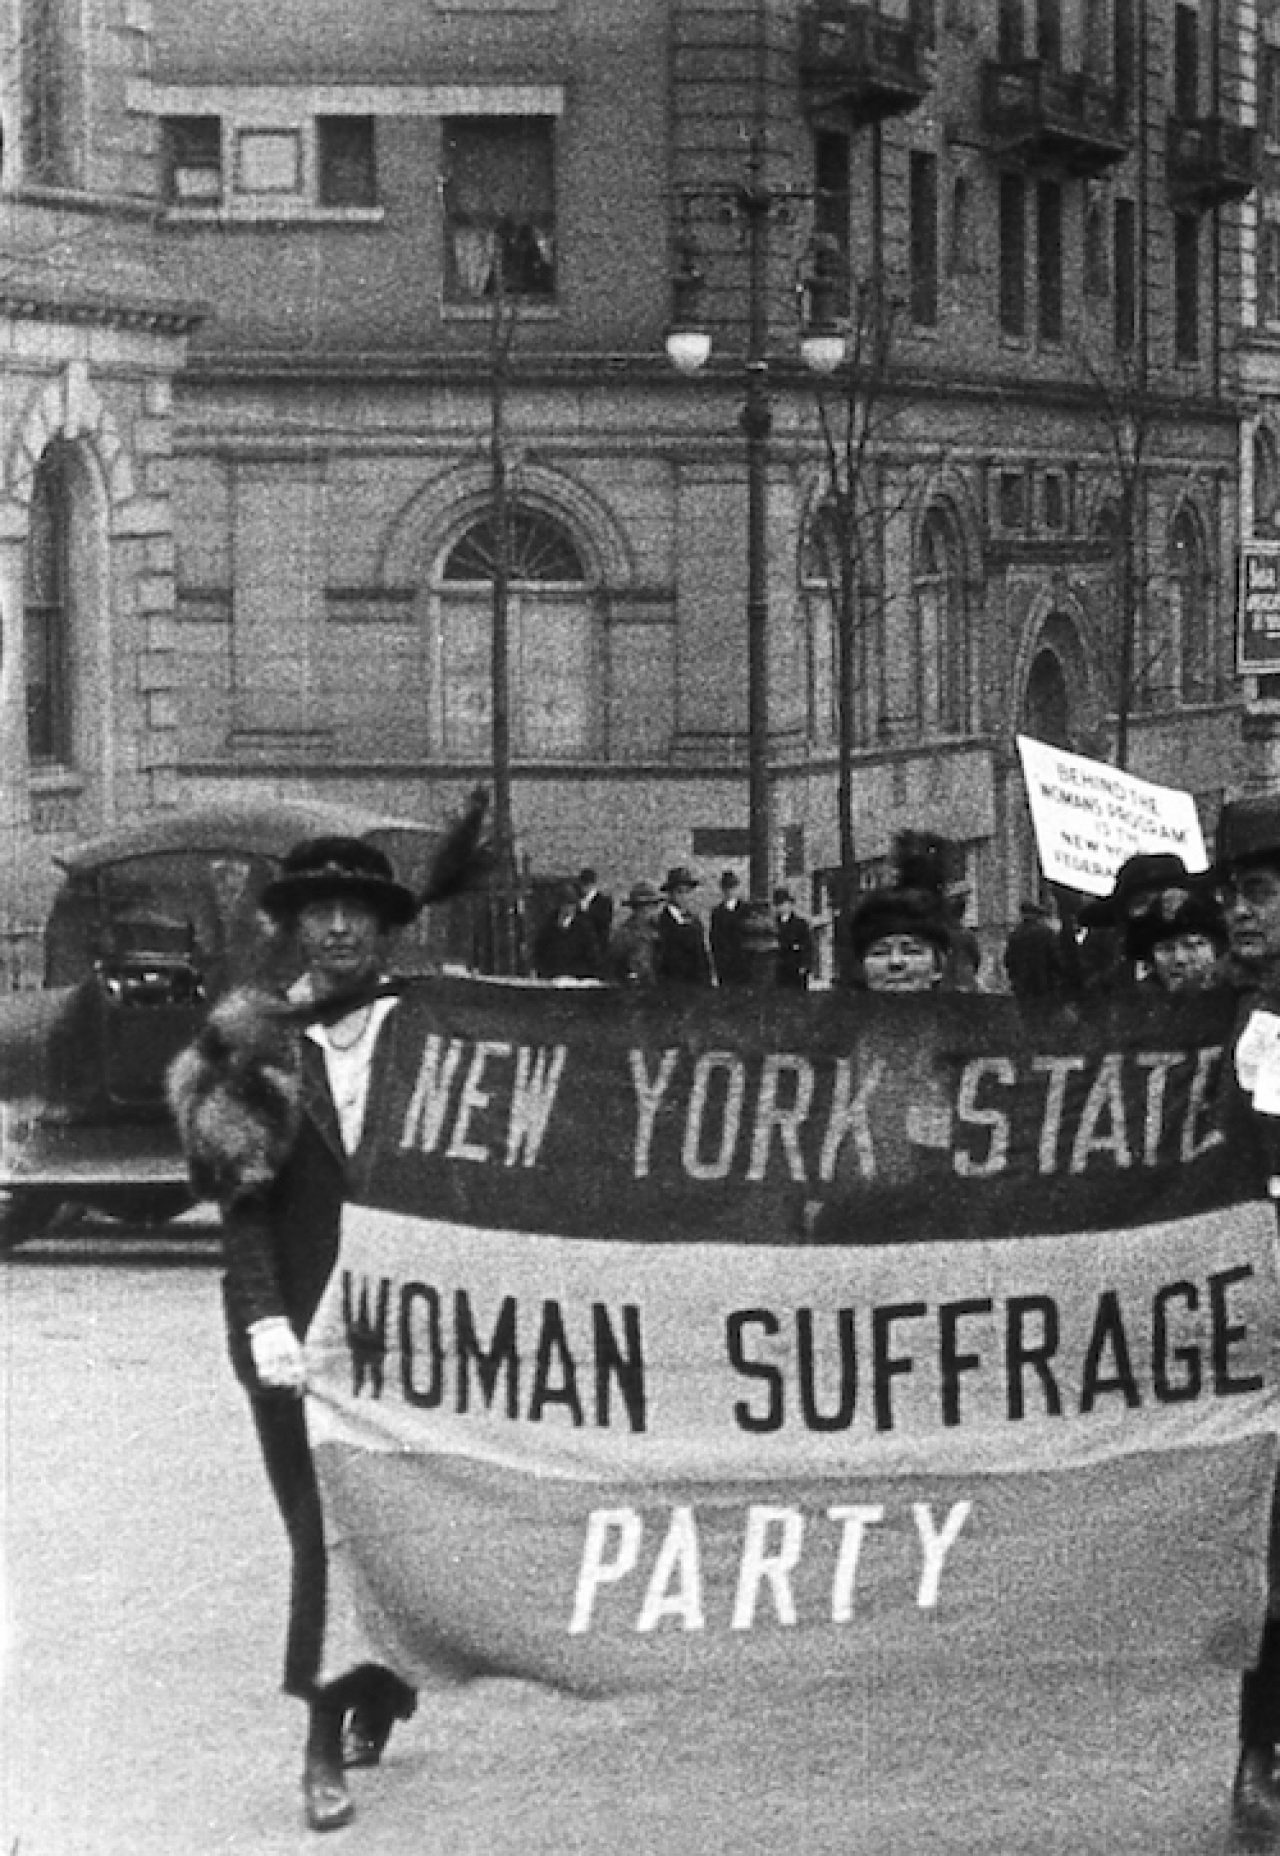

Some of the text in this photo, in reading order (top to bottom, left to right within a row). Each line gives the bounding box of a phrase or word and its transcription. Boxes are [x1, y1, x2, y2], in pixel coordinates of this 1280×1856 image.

[400, 1033, 1226, 1183] NEW YORK STATE
[342, 1264, 1264, 1434] WOMAN SUFFRAGE
[568, 1499, 972, 1635] PARTY
